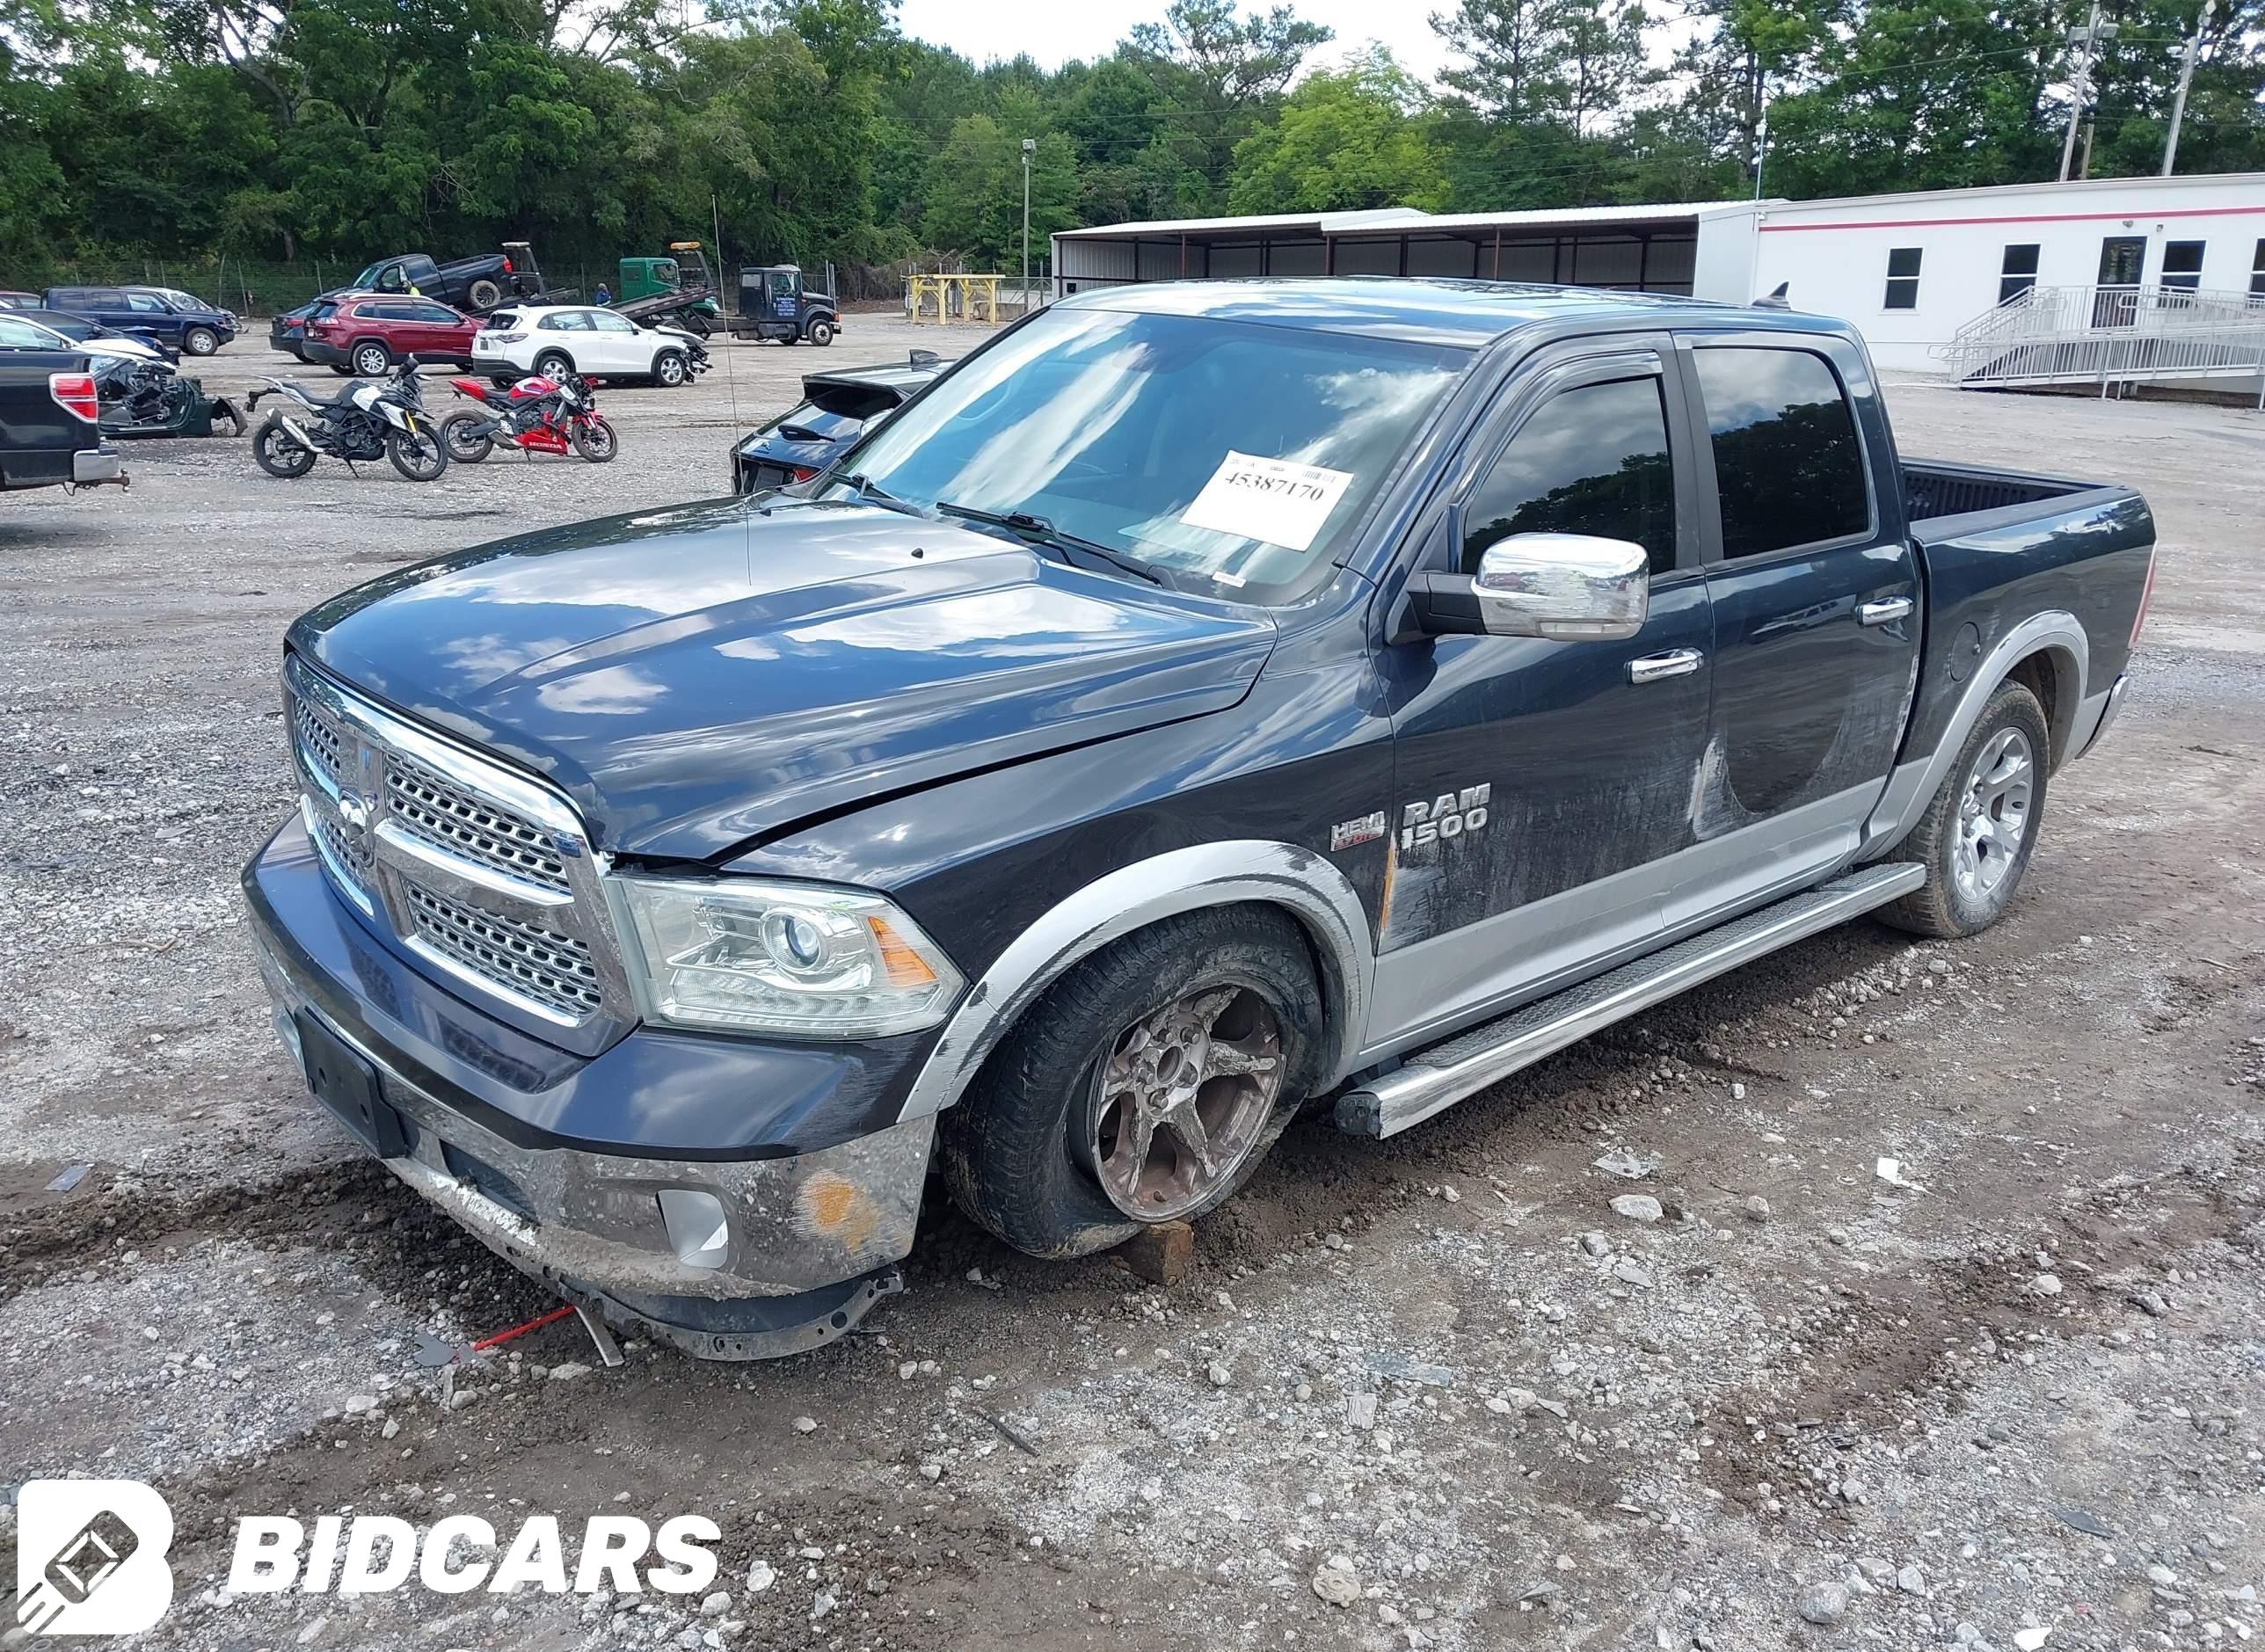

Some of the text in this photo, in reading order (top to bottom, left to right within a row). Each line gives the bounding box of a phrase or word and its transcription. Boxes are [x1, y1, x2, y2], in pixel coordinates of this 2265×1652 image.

[1226, 472, 1323, 500] 45387170
[1403, 782, 1490, 826] RAM
[1331, 811, 1385, 841] HEMI
[1401, 807, 1488, 849] 1500
